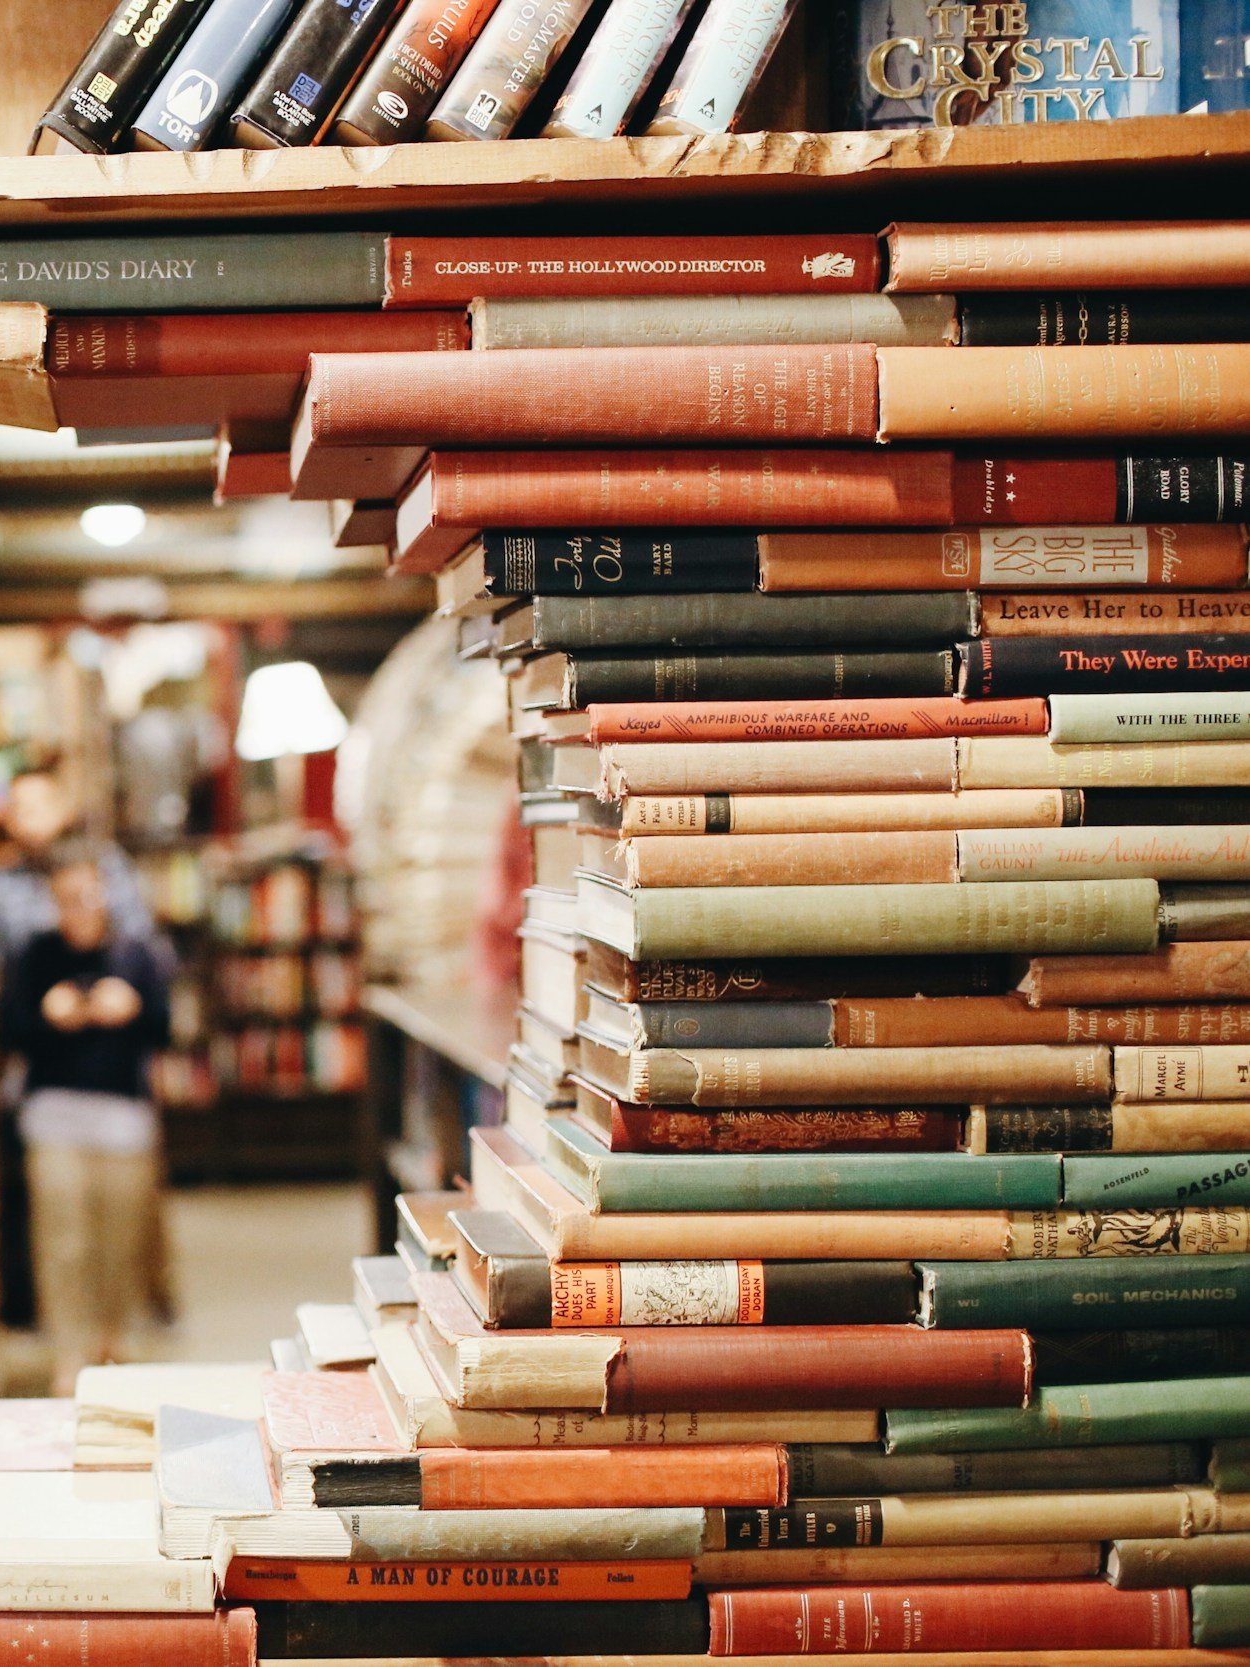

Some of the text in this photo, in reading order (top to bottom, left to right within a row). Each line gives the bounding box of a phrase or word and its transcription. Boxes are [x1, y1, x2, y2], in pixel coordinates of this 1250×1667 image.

[926, 2, 1030, 40] THE
[392, 66, 413, 85] BOOK
[398, 57, 440, 94] SHANNARA
[399, 42, 443, 80] HIGH DRUID
[866, 36, 1165, 100] CRYSTAL
[74, 104, 97, 123] BOOKS
[276, 109, 300, 127] BOOKS
[469, 109, 489, 127] eos
[585, 113, 603, 125] ACE
[698, 108, 715, 120] ACE
[933, 81, 1105, 128] CITY
[158, 111, 193, 144] TOR
[16, 260, 111, 283] DAVID'S
[120, 258, 198, 281] DIARY
[217, 260, 226, 277] FOX
[434, 258, 767, 276] CLOSE-UP: THE HOLLYWOOD DIRECTOR
[707, 365, 722, 426] BEGINS
[732, 363, 746, 427] REASON
[753, 383, 766, 406] OF
[773, 359, 788, 430] THE AGE
[806, 368, 816, 418] DURANT
[982, 459, 995, 515] Doubleday
[1158, 469, 1170, 501] ROAD
[1178, 465, 1191, 505] GLORY
[1232, 460, 1246, 508] Potomac:
[652, 543, 661, 576] MARY
[663, 543, 673, 576] BARD
[992, 535, 1037, 578] SKY
[1042, 535, 1086, 575] BIG
[1091, 533, 1143, 574] THE
[1154, 526, 1183, 584] Guthrie
[998, 597, 1250, 621] Leave Her to Heave
[981, 638, 991, 673] WHITE
[1058, 649, 1179, 674] They Were
[619, 710, 870, 735] Keyes AMPHIBIOUS WARFARE AND
[745, 721, 909, 736] COMBINED OPERATIONS
[945, 713, 1022, 728] Macmillan
[1116, 713, 1241, 726] WITH THE THREE
[651, 802, 661, 825] Faith
[970, 841, 1046, 855] WILLIAM
[979, 857, 1038, 871] GAUNT
[1056, 834, 1194, 864] THE Aesthetic
[864, 1009, 876, 1045] PETER
[1154, 1054, 1166, 1098] MARCEL
[1173, 1058, 1187, 1092] AYMÉ
[1103, 1166, 1151, 1192] ROSENFELD
[1175, 1158, 1250, 1202] PASSAG
[1186, 1224, 1198, 1248] The
[572, 1269, 583, 1287] HIS
[605, 1263, 614, 1325] DON MARQUIS
[740, 1264, 750, 1323] DOUBLEDAY
[555, 1270, 570, 1321] ARCHY
[586, 1278, 598, 1312] PART
[752, 1277, 762, 1313] DORAN
[1071, 1286, 1238, 1306] SOIL MECHANICS
[571, 1419, 585, 1434] of
[346, 1566, 560, 1587] A MAN OF COURAGE
[8, 1593, 111, 1603] HILLESUM
[835, 1599, 847, 1650] Jeffersonians
